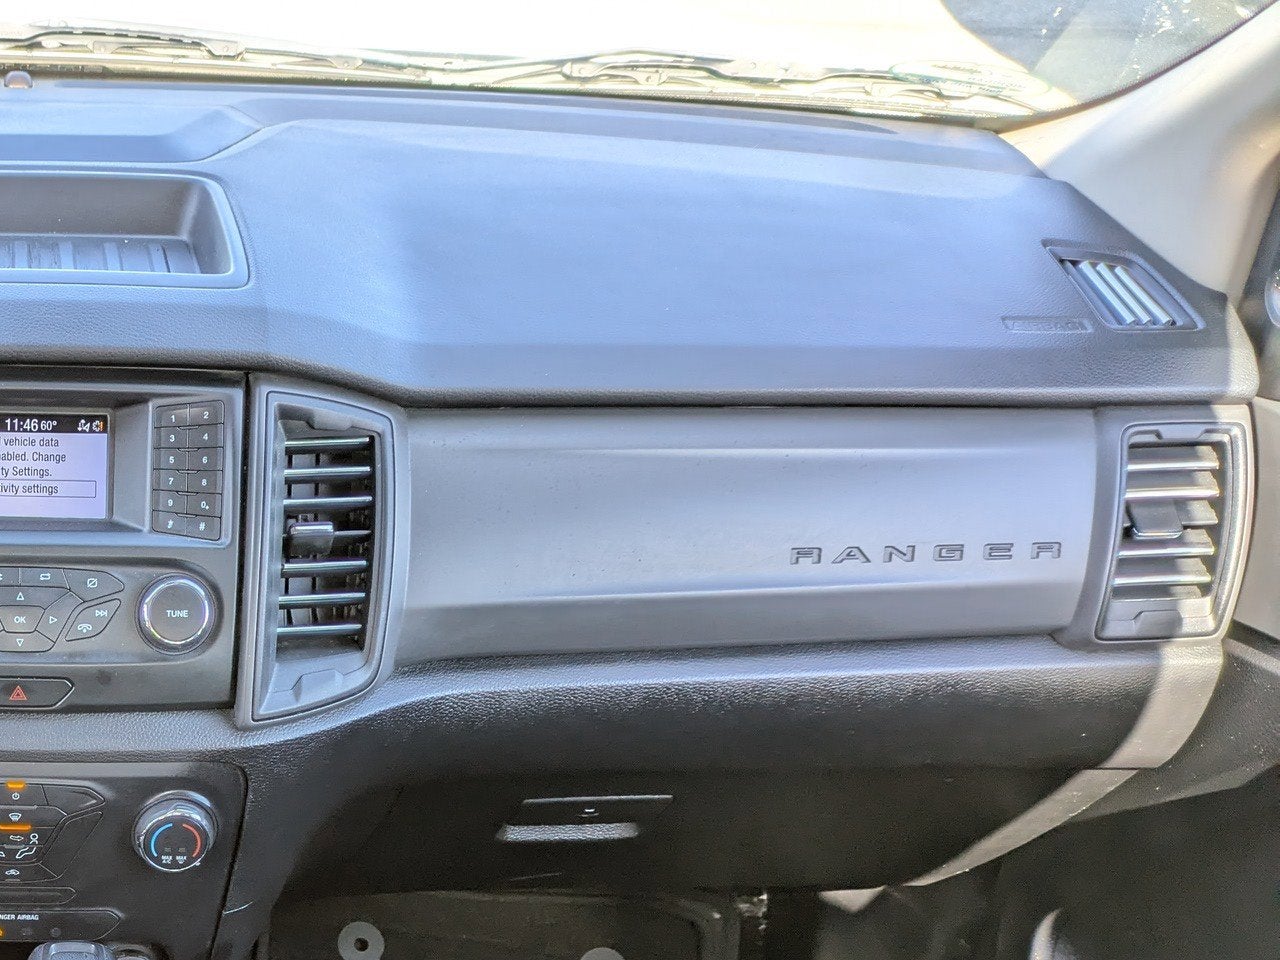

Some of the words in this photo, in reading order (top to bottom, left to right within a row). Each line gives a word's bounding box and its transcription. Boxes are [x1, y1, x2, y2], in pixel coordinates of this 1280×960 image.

[203, 411, 209, 419] 2
[5, 418, 39, 432] 11:46
[169, 434, 175, 442] 3
[202, 433, 208, 441] 4
[4, 436, 36, 447] vehicle
[39, 437, 59, 448] data
[32, 452, 66, 464] Change
[202, 456, 208, 464] 6
[12, 466, 52, 479] Settings.
[168, 477, 174, 485] 7
[201, 478, 207, 486] 8
[22, 483, 59, 495] settings
[167, 499, 173, 507] 9
[789, 541, 1062, 565] RANGER
[166, 609, 189, 618] TUNE
[14, 616, 26, 624] OK
